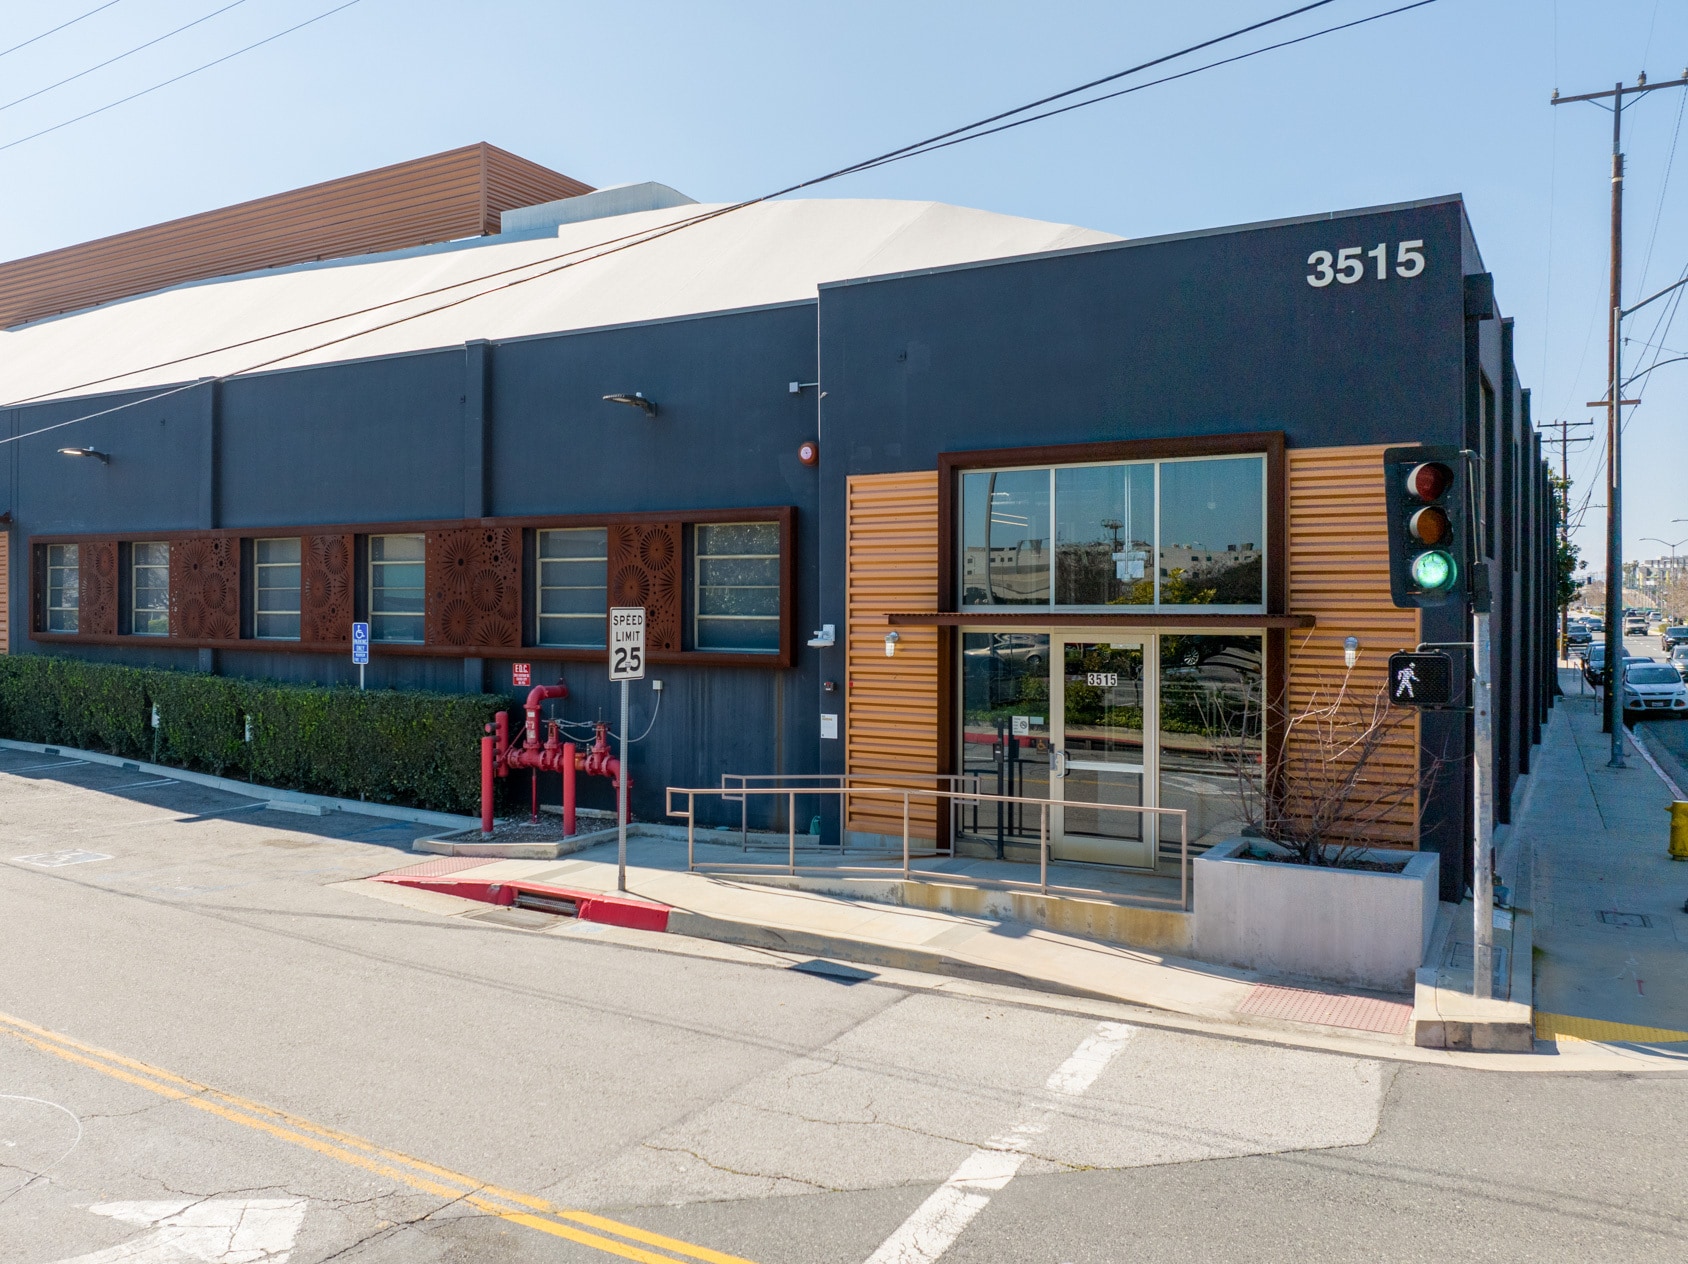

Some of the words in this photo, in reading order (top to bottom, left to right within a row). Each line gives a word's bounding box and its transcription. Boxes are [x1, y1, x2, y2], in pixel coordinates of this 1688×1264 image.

[1306, 239, 1425, 288] 3515
[613, 615, 643, 626] SPEED
[616, 630, 640, 642] LIMIT
[614, 647, 641, 673] 25
[1088, 673, 1117, 686] 3515
